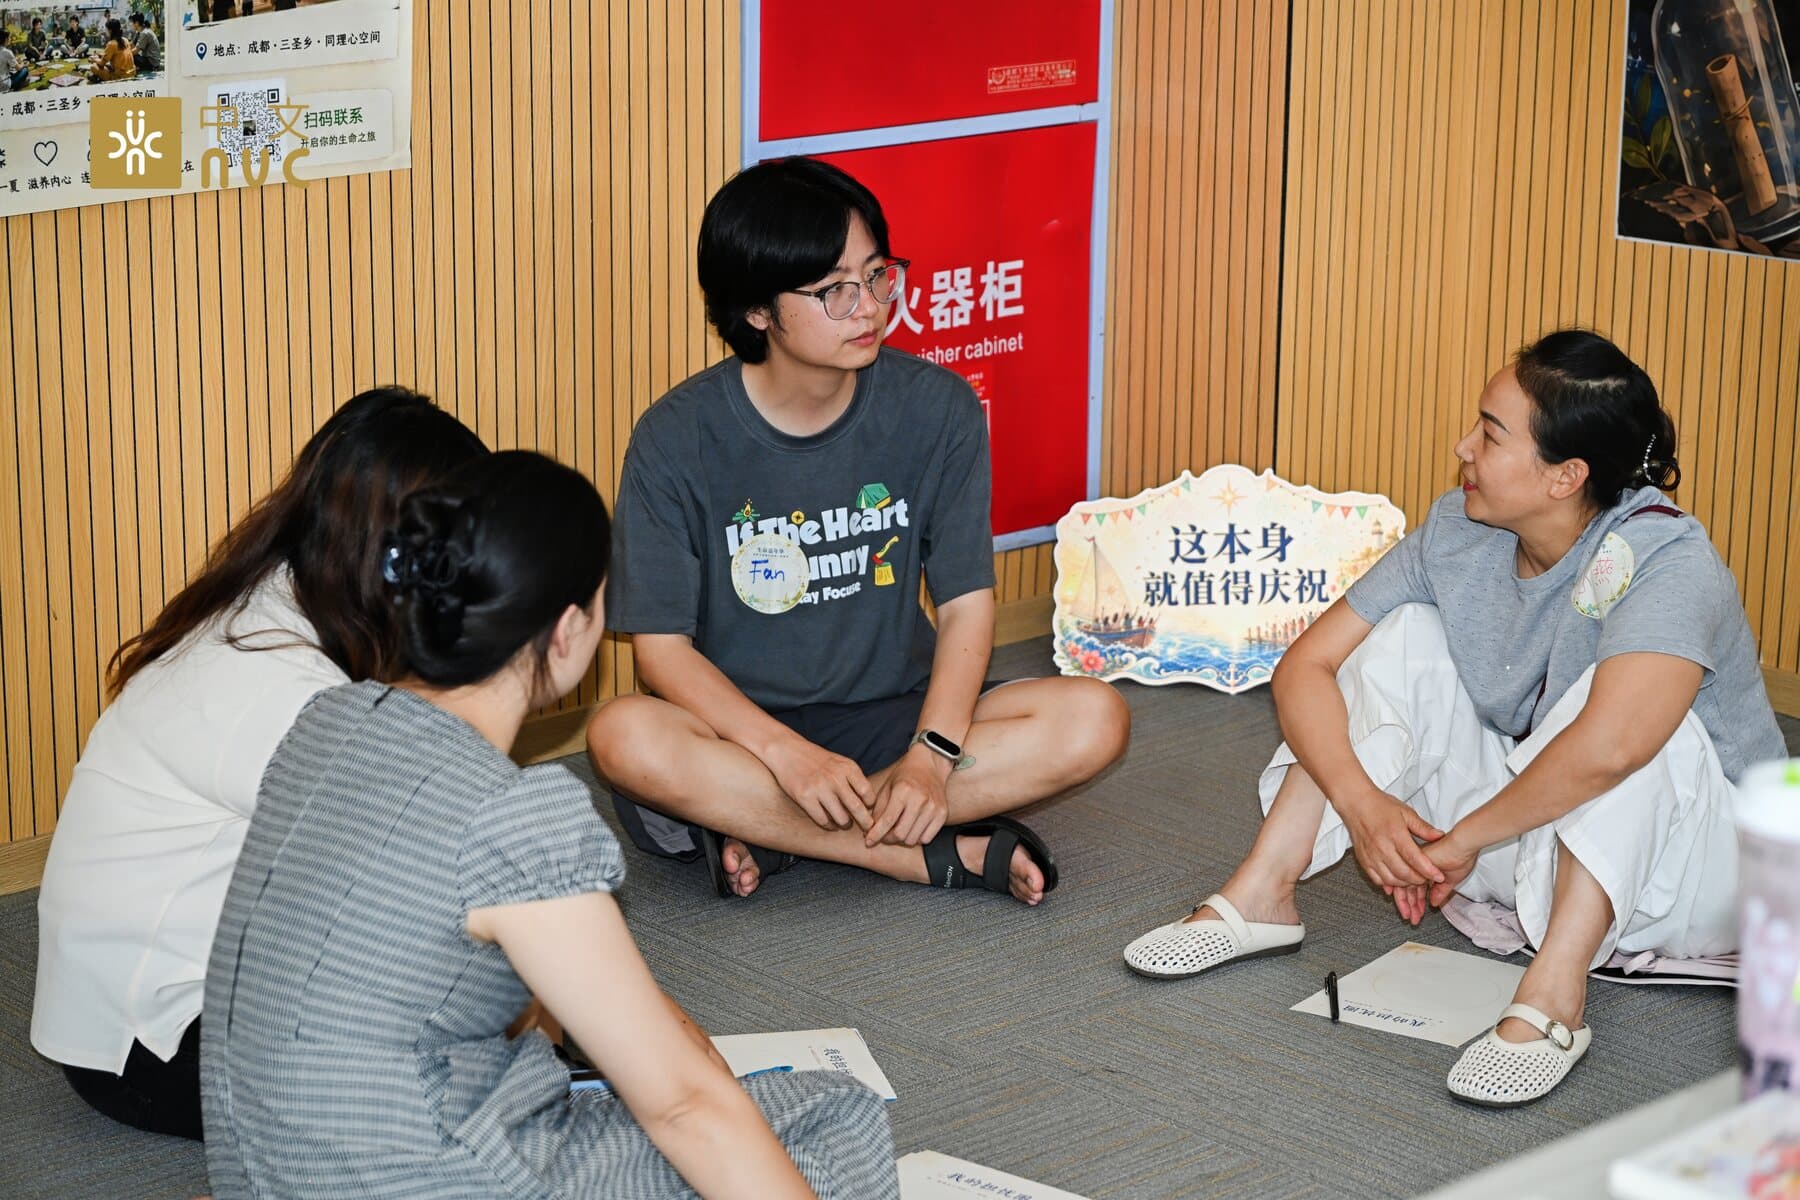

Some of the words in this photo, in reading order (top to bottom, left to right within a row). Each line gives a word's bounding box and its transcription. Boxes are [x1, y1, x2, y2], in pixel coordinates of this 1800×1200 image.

[303, 107, 364, 130] 扫码联系
[300, 131, 377, 150] 开启你的生命之旅
[27, 174, 72, 190] 滋养内心
[916, 345, 961, 364] isher
[965, 332, 1023, 360] cabinet
[821, 498, 909, 542] Heart
[1168, 521, 1294, 565] 这本身
[749, 559, 785, 584] Fan
[799, 591, 819, 605] ay
[1143, 568, 1331, 607] 就值得庆祝
